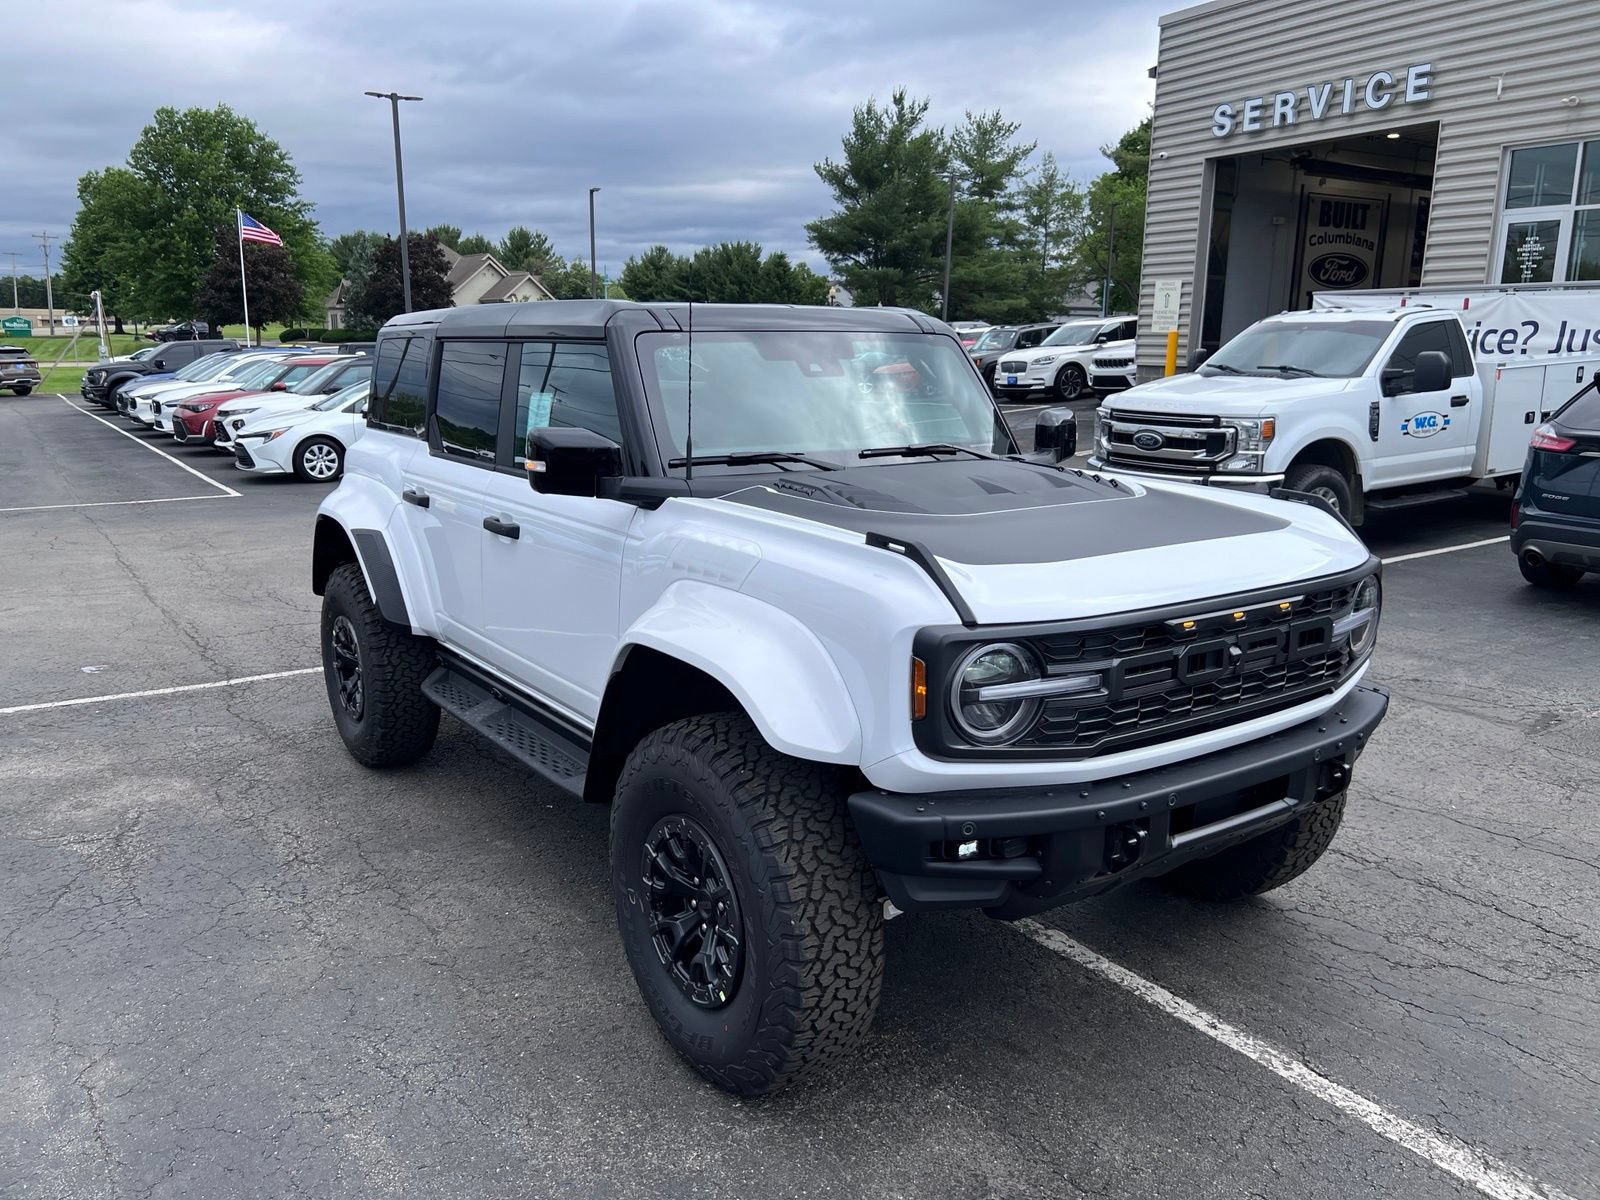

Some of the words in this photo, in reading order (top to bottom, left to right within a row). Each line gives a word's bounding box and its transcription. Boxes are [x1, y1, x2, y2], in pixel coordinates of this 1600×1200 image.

[1211, 63, 1432, 137] SERVICE
[1318, 200, 1371, 230] BUILT
[1308, 231, 1374, 251] Columbiana
[1320, 258, 1359, 282] Ford
[1414, 415, 1439, 430] W.G.
[1110, 614, 1334, 703] FORD
